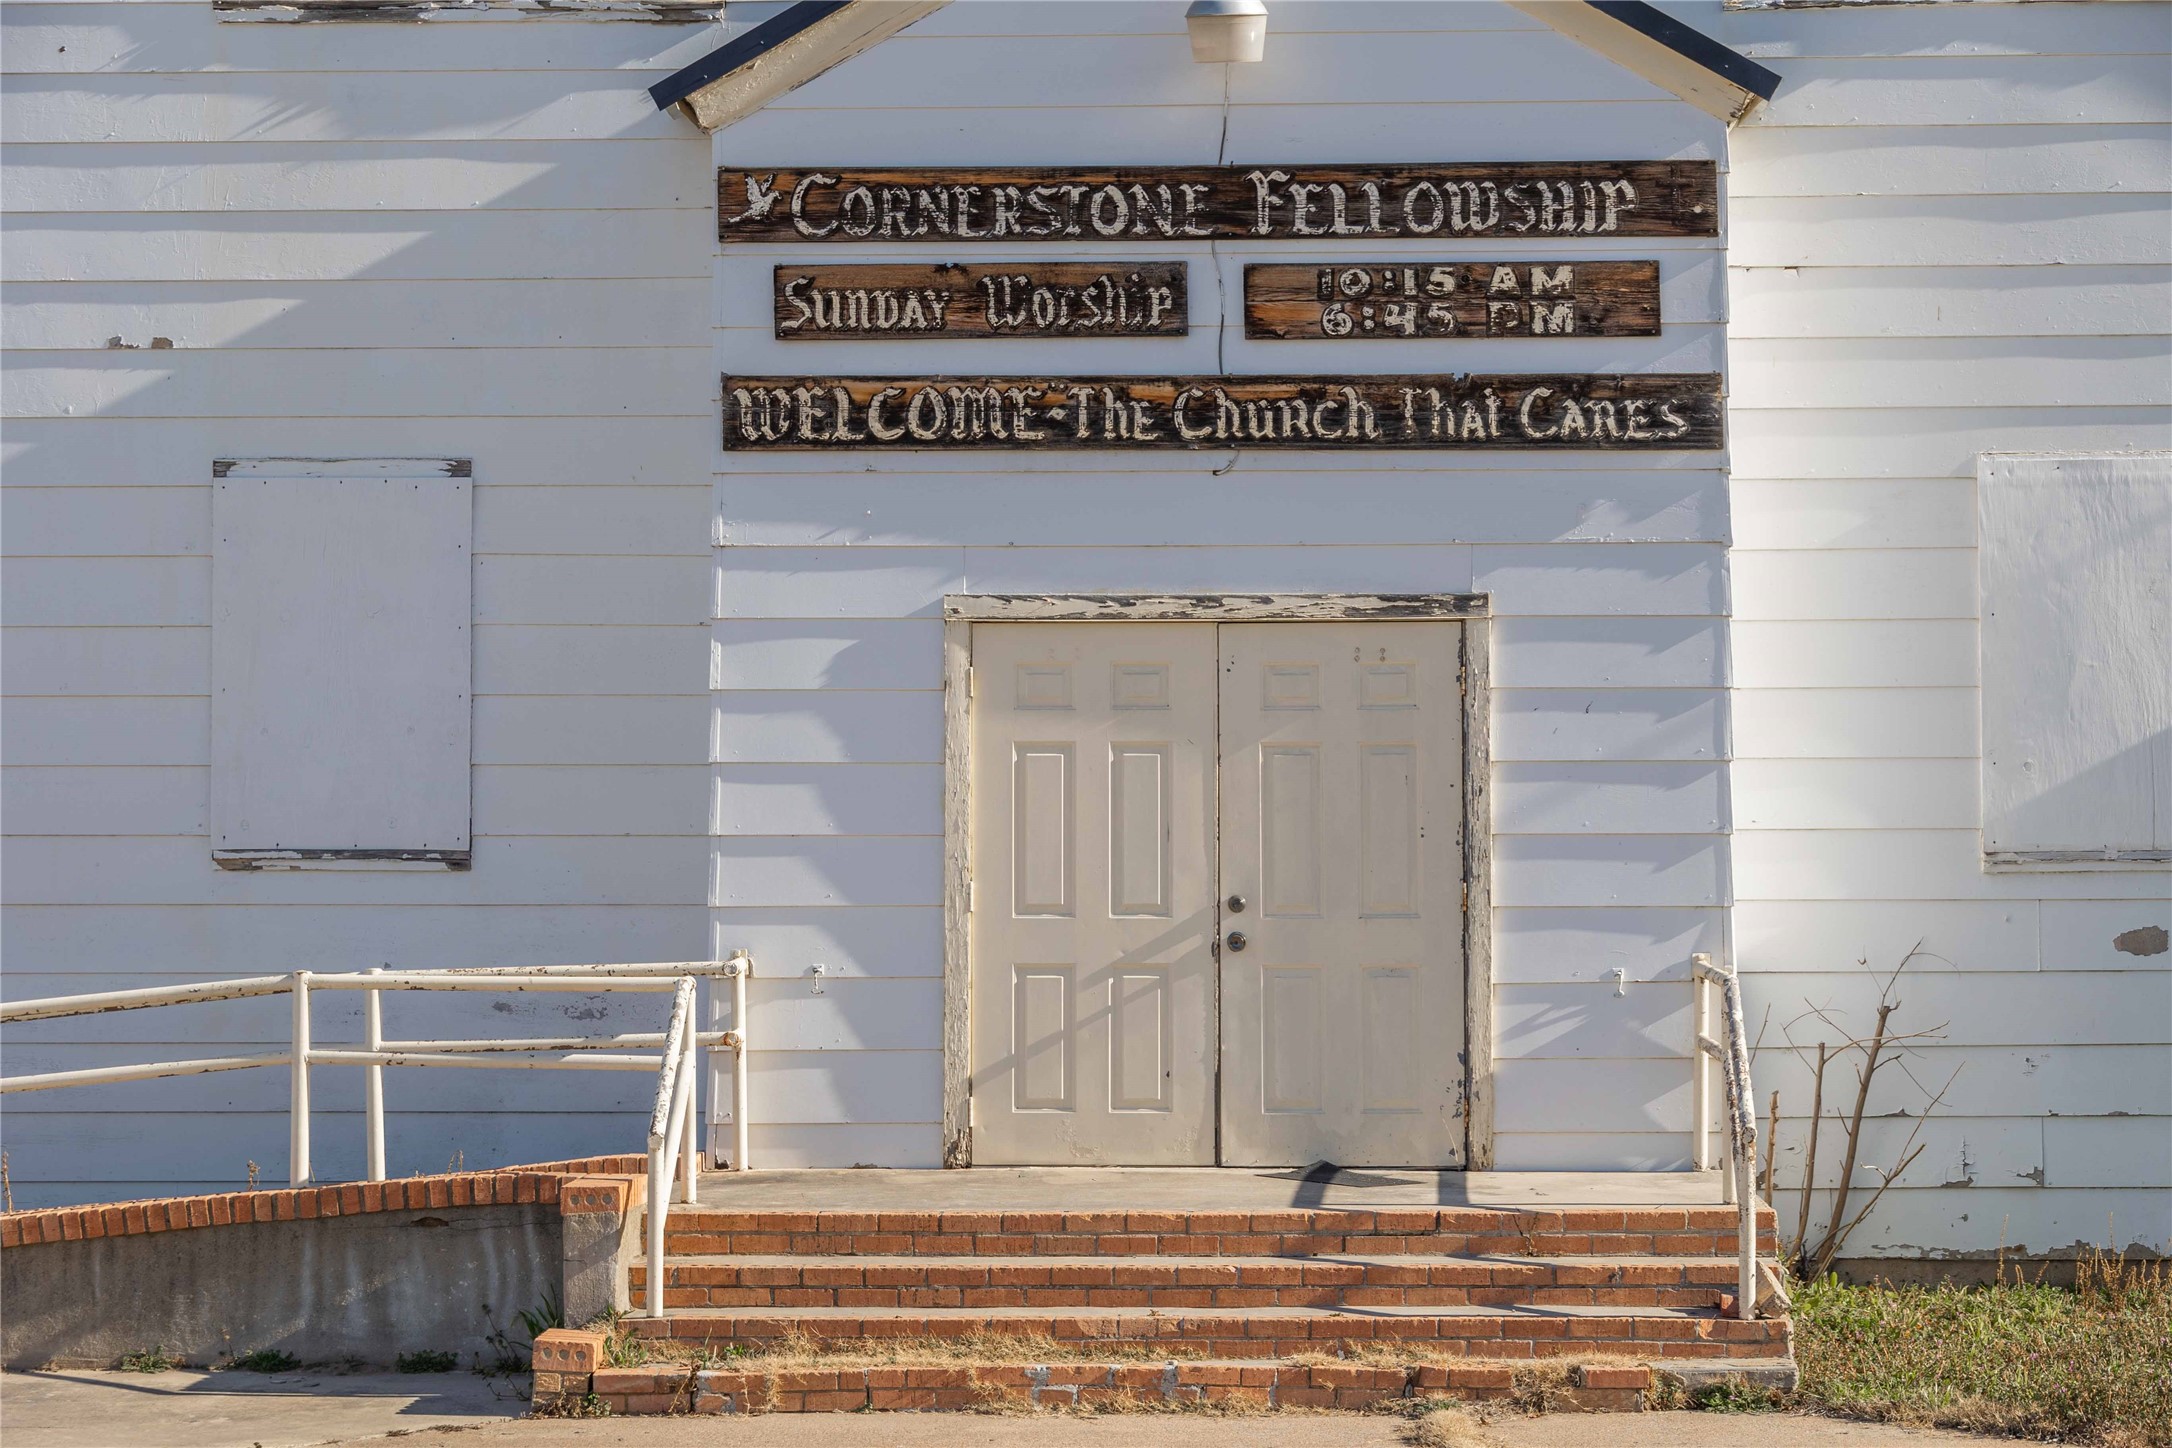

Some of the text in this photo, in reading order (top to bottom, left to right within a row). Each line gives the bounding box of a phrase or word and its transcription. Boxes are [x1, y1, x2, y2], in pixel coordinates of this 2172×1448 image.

[791, 170, 1638, 238] CORNERSTONE FELLOWSHIP
[1318, 266, 1575, 298] 10:15 AM
[1321, 301, 1576, 338] 6:45 PM
